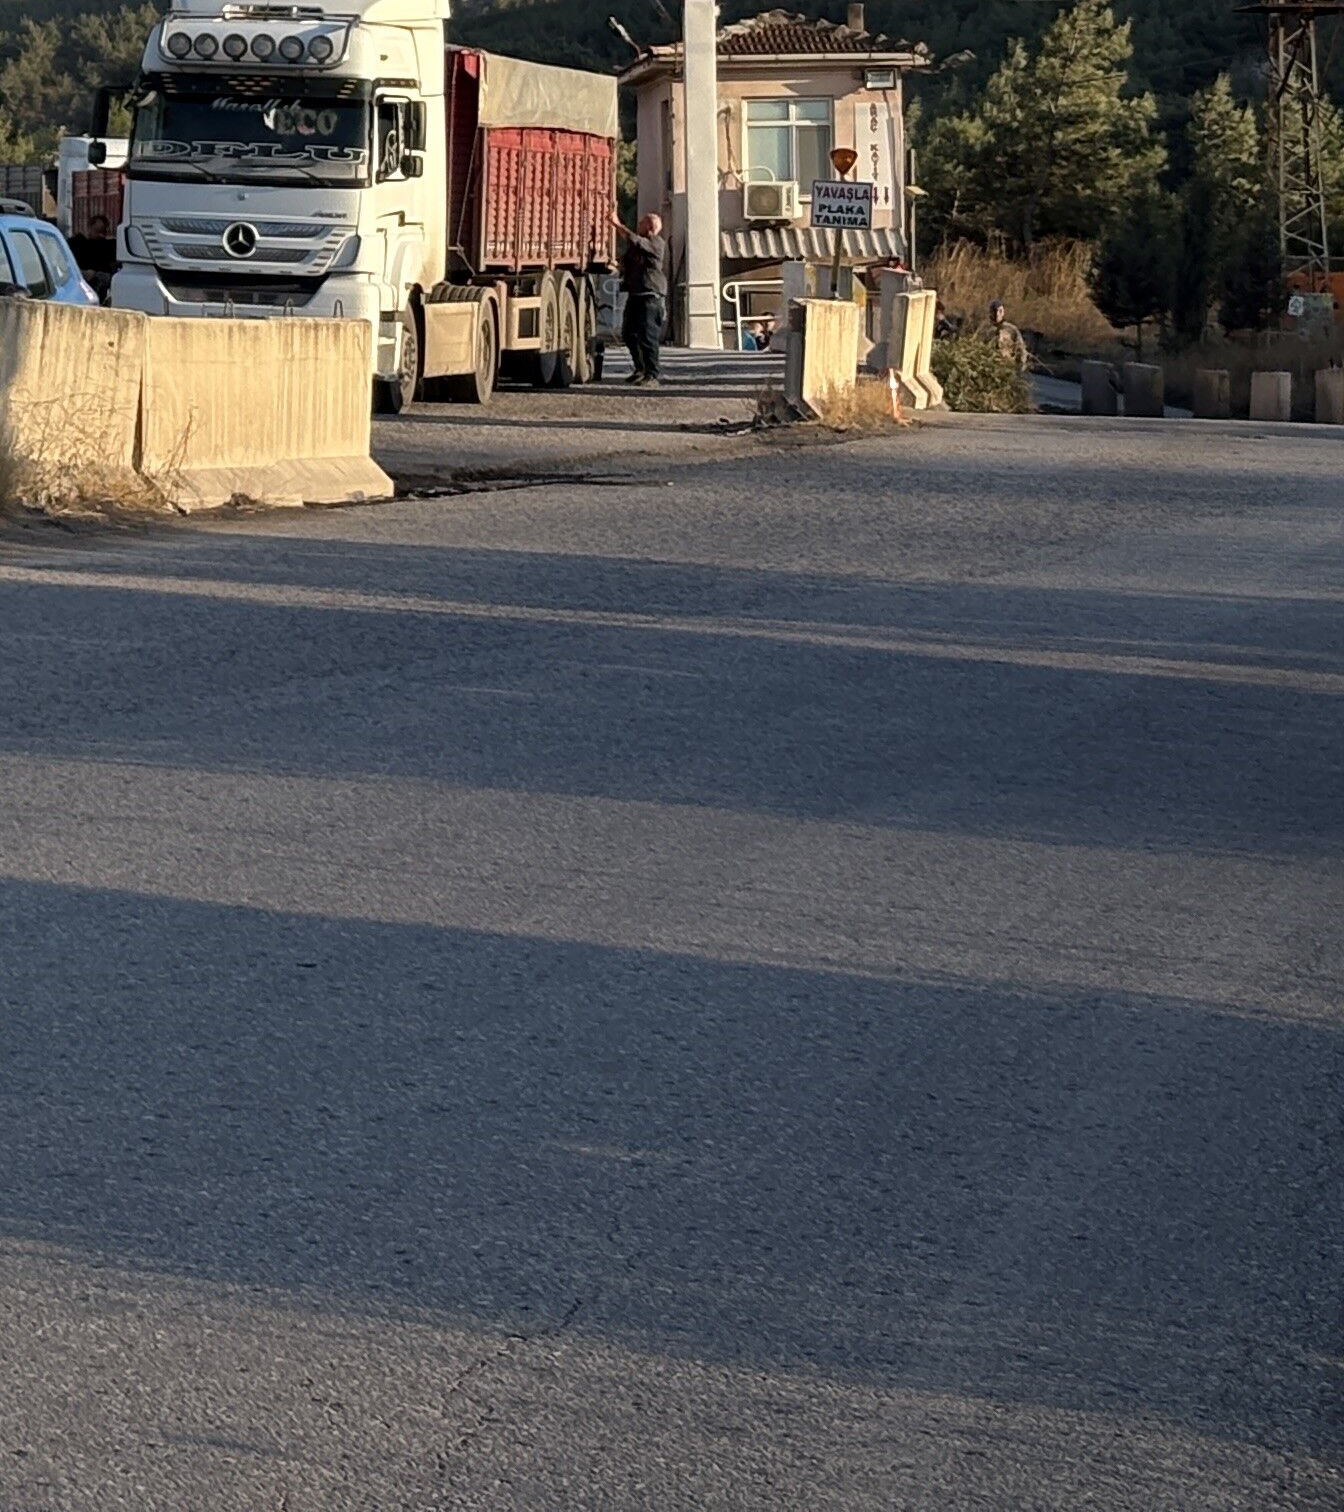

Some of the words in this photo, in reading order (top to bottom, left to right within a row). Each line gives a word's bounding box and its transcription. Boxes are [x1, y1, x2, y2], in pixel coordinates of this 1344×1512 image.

[816, 186, 870, 202] YAVAŞLA
[818, 203, 865, 216] PLAKA
[815, 214, 868, 227] TANIMA
